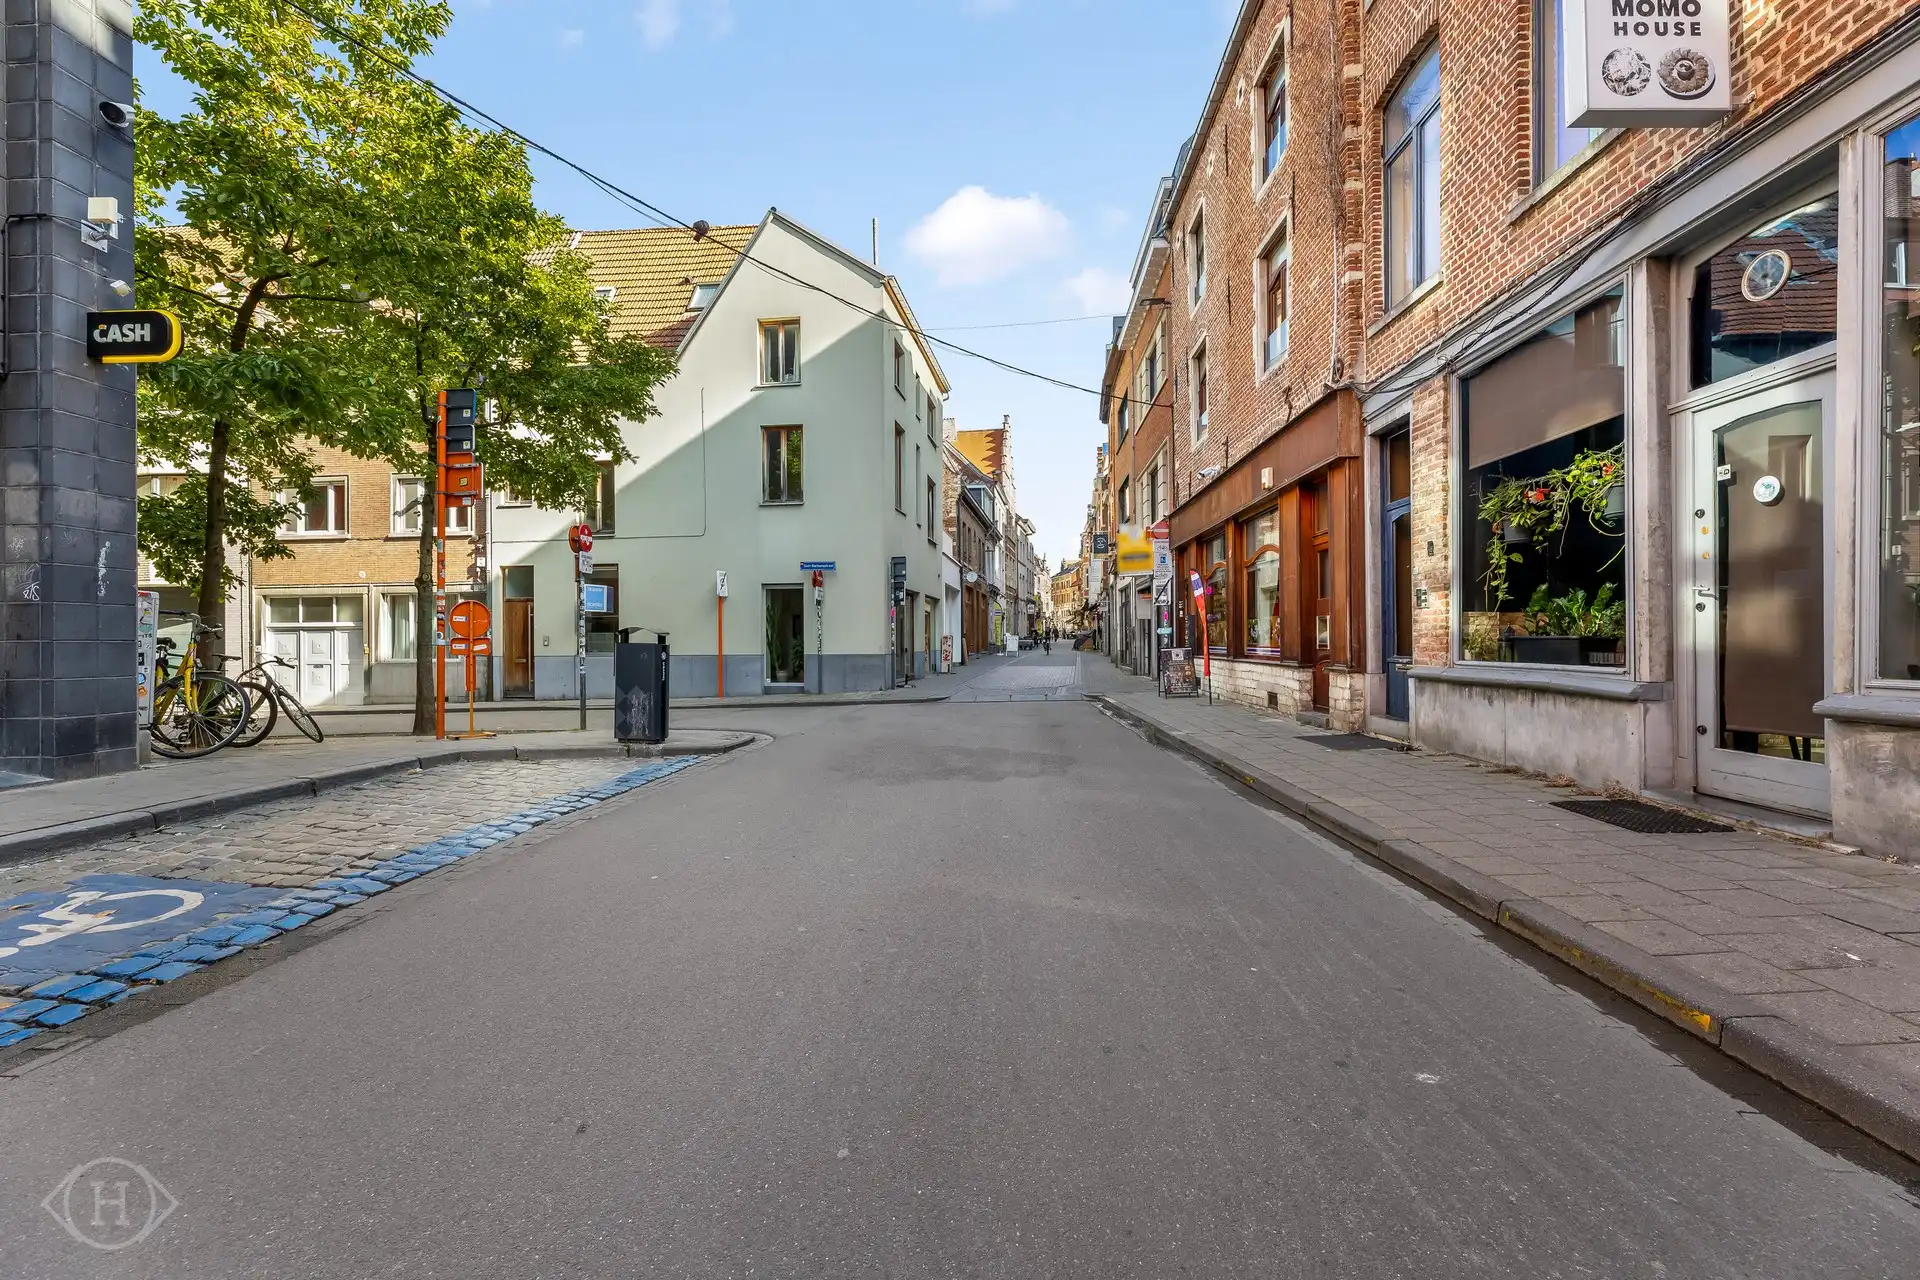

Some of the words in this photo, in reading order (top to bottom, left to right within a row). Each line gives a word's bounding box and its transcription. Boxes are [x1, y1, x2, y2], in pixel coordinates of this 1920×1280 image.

[1611, 0, 1701, 17] MOMO
[1613, 21, 1702, 36] HOUSE
[93, 323, 151, 343] CASH
